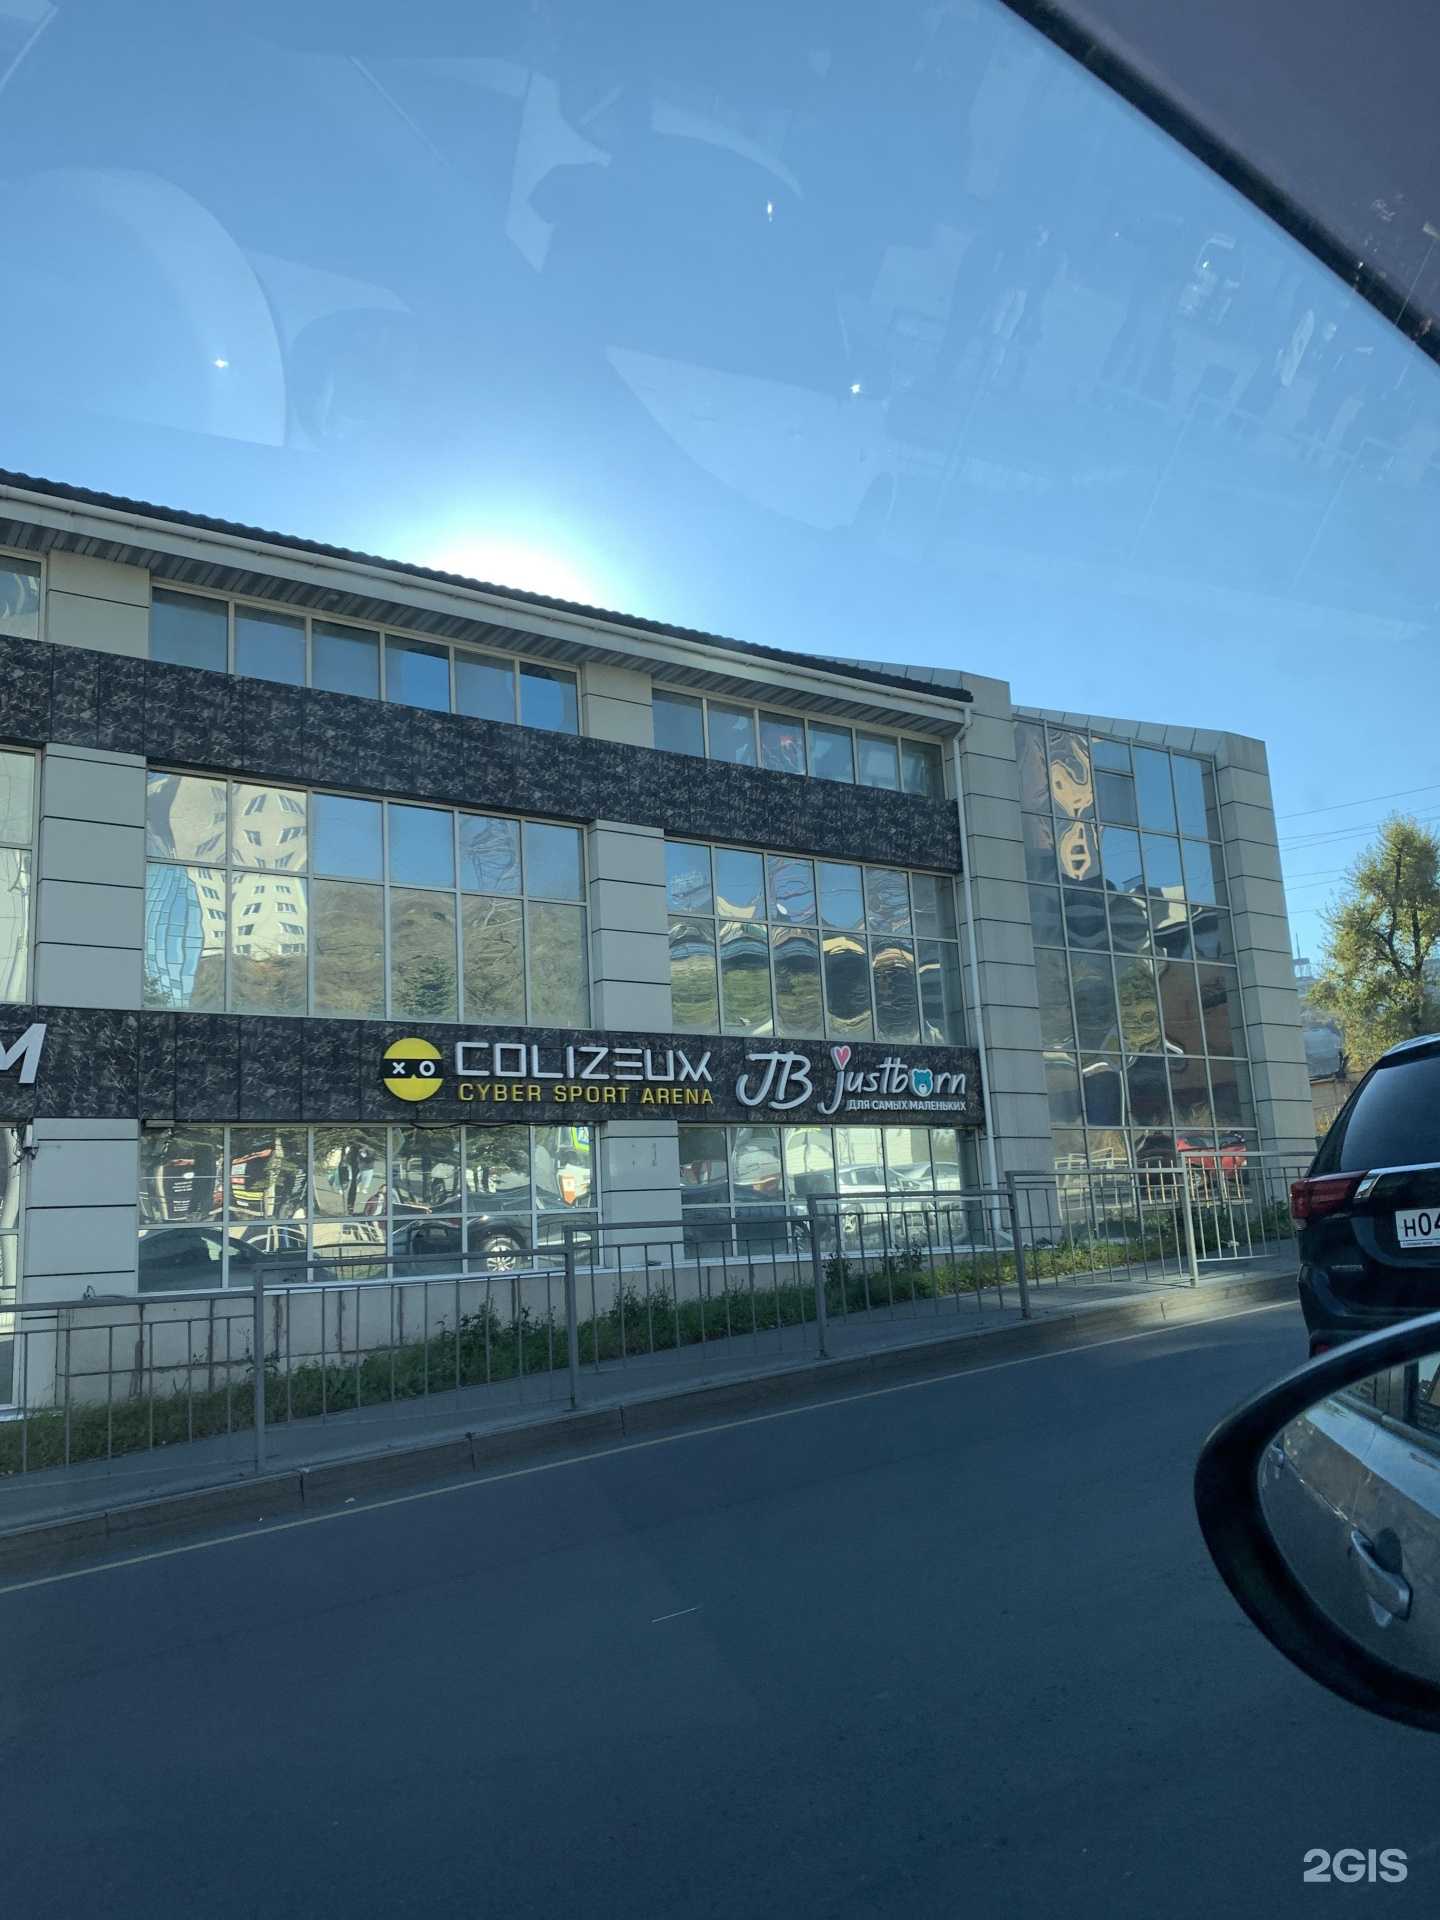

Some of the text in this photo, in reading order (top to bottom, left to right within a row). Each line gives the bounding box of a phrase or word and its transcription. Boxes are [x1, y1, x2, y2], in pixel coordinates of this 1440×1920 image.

[455, 1041, 713, 1082] COLIZEUM
[458, 1083, 714, 1105] CYBER SPORT ARENA
[736, 1051, 813, 1110] JB
[848, 1099, 967, 1111] ДЛЯ САМЫХ МАЛЕНЬКИХ
